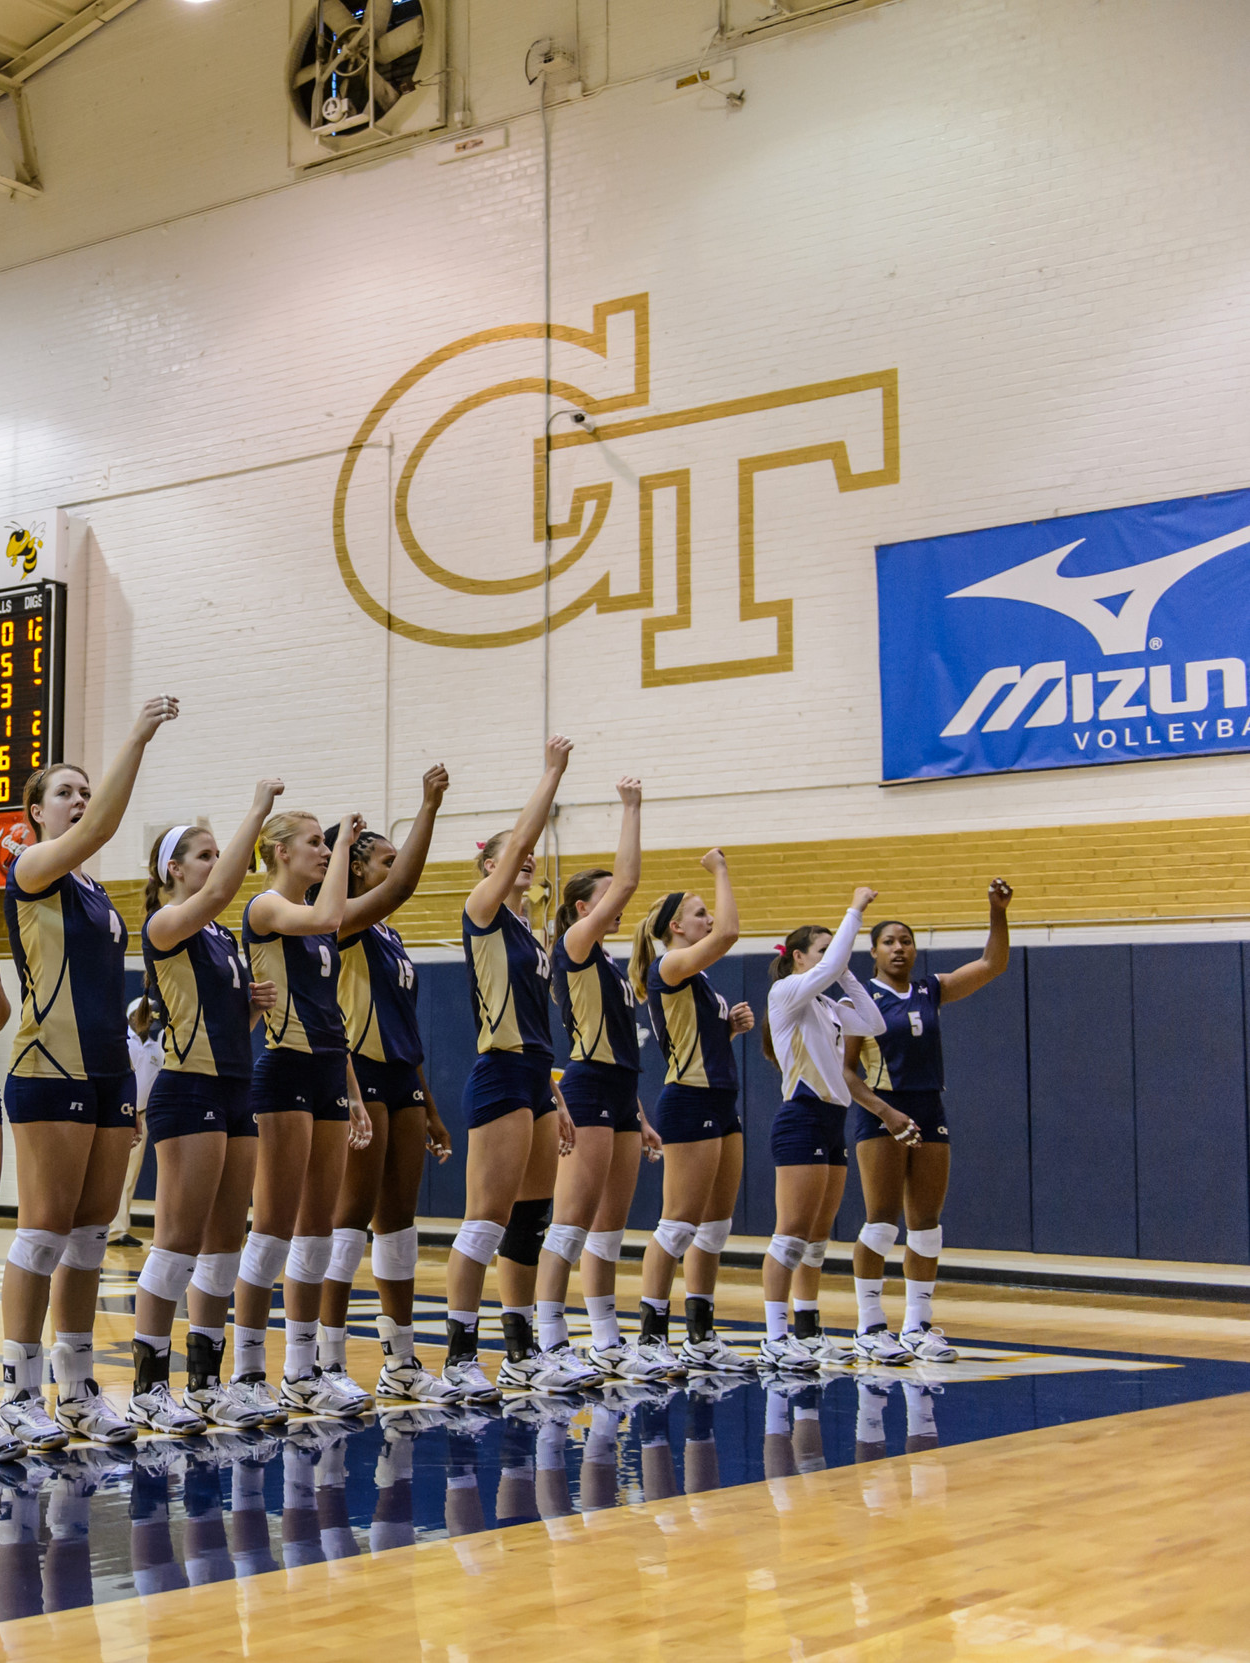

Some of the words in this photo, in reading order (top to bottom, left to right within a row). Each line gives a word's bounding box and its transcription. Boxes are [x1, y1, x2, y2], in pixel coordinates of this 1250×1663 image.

[333, 291, 899, 688] GT
[1, 621, 14, 647] 0
[1, 652, 13, 678] 5
[1, 683, 12, 709] 3
[109, 909, 121, 943] 4
[318, 945, 331, 977] 9
[907, 1011, 923, 1036] 5
